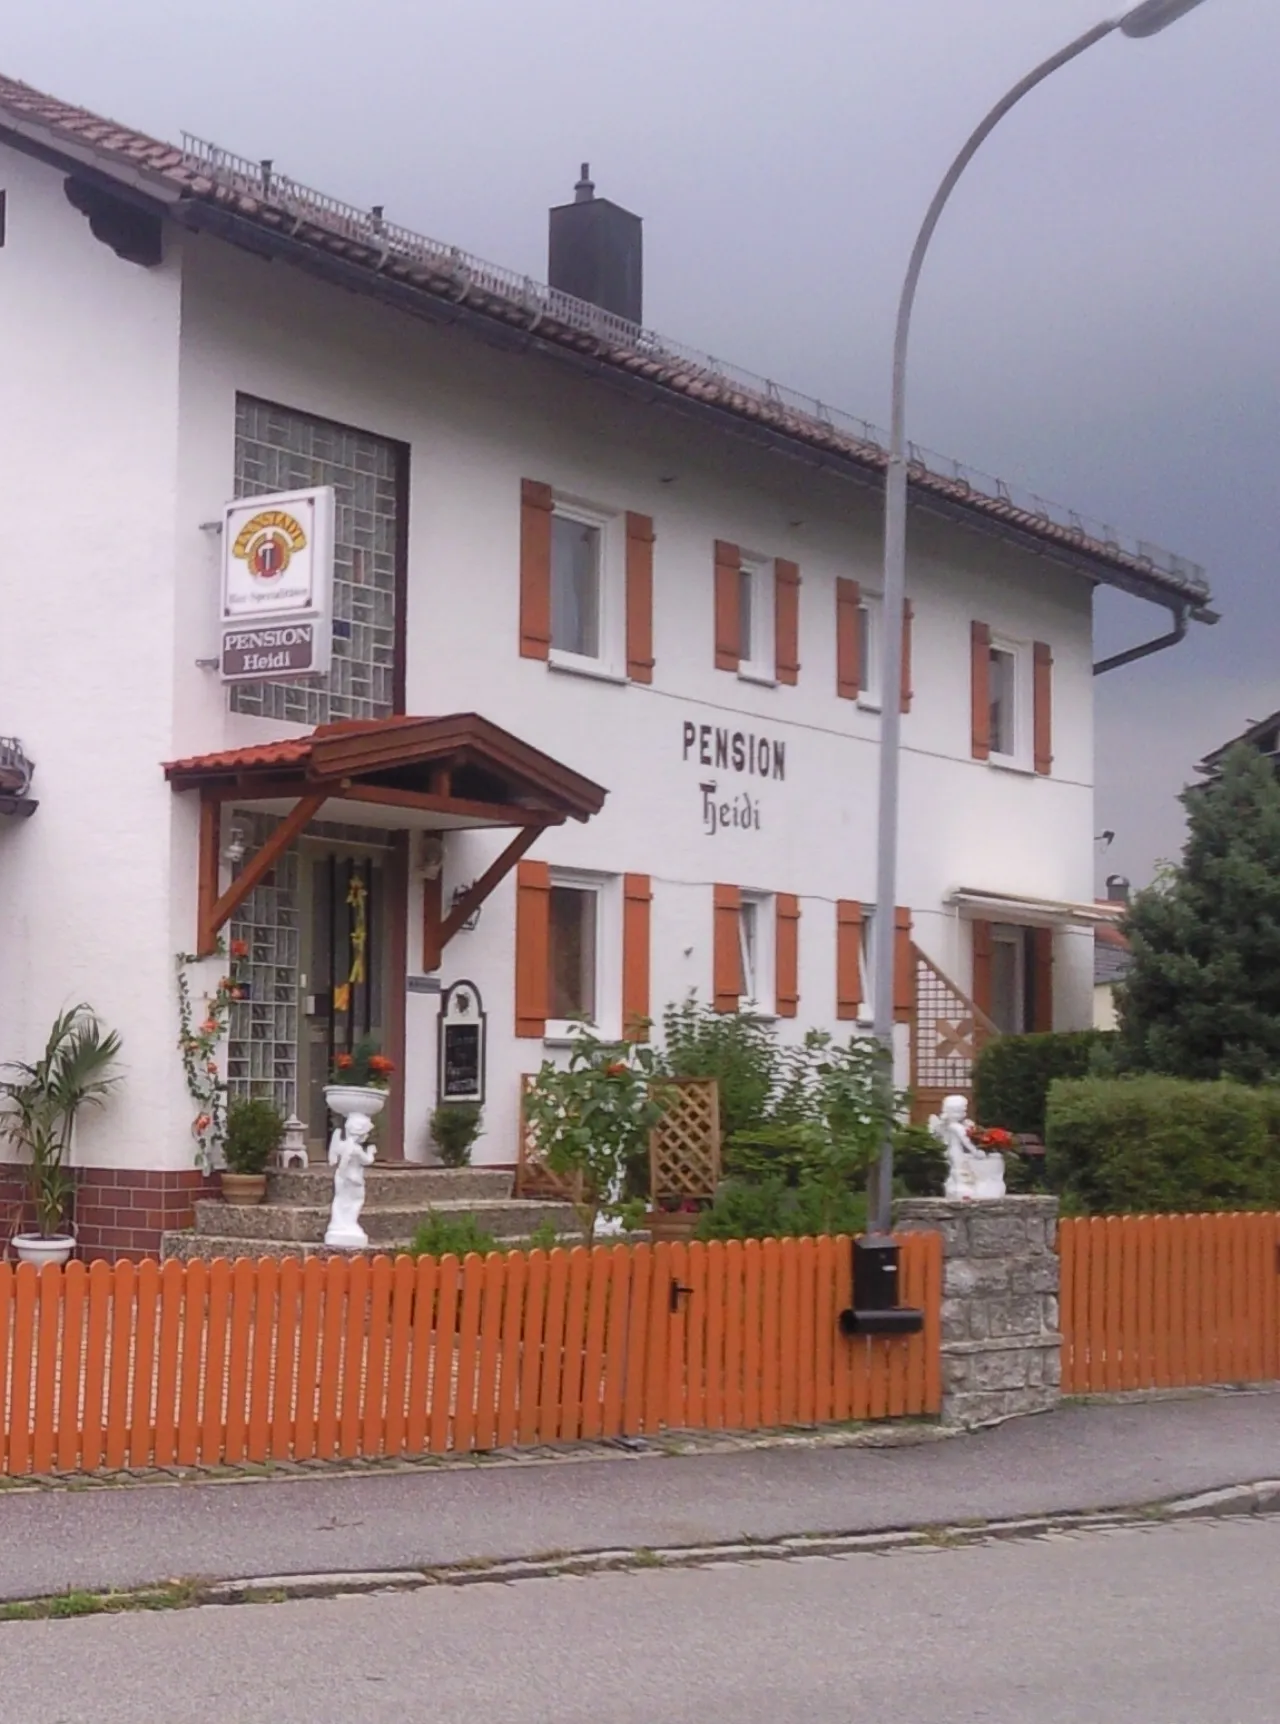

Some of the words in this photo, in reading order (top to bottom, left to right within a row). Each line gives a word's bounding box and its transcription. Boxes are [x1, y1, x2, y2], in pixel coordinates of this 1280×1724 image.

[224, 627, 312, 651] PENSION
[243, 650, 291, 671] Heidi
[683, 720, 785, 781] PENSION
